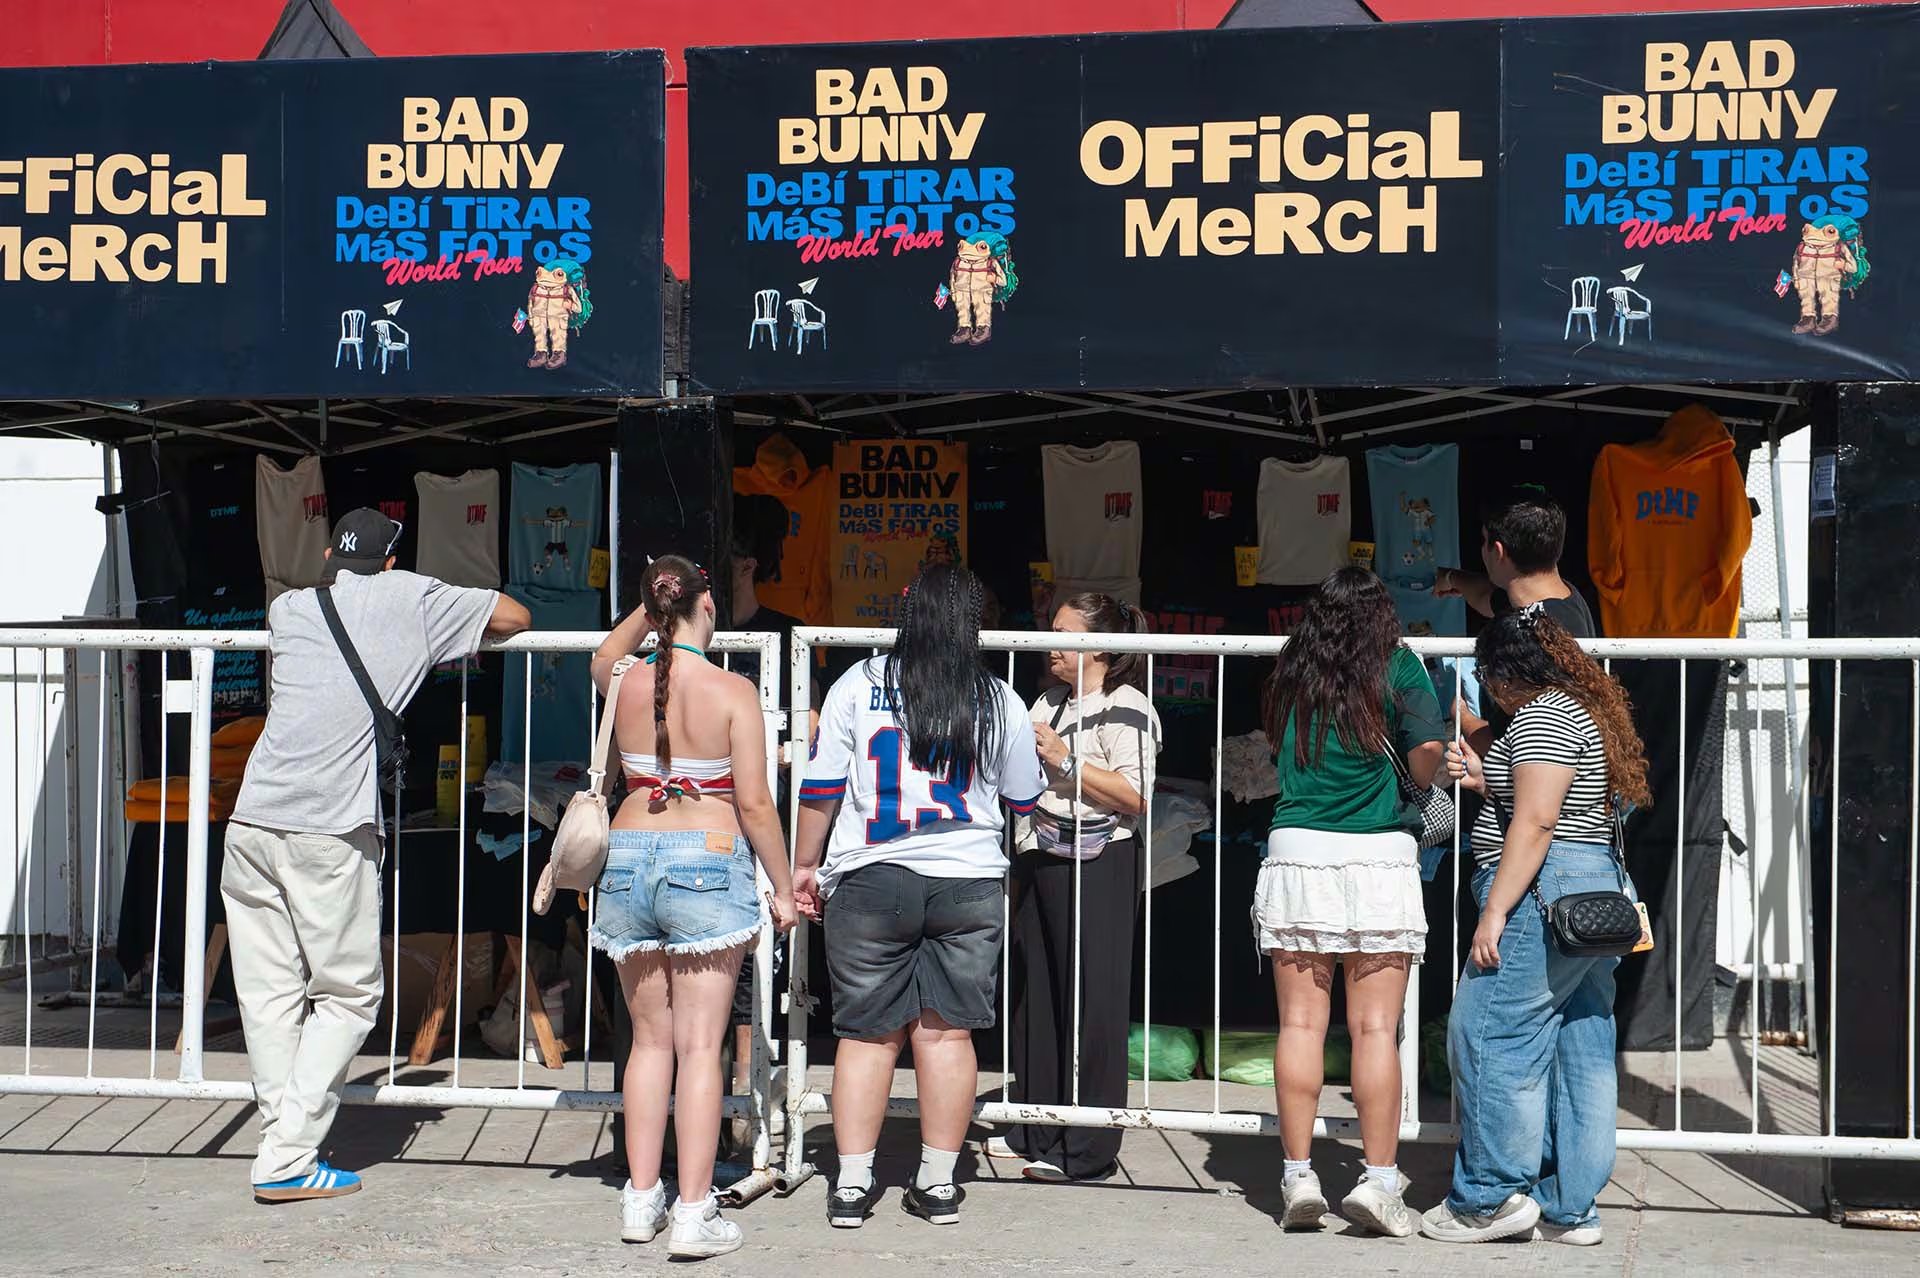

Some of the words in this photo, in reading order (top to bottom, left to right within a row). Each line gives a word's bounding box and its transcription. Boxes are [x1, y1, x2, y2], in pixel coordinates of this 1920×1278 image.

[1645, 40, 1795, 92] BAD
[815, 66, 948, 116] BAD
[403, 97, 529, 143] BAD
[1602, 88, 1838, 144] BUNNY
[778, 112, 986, 165] BUNNY
[1080, 110, 1483, 188] OFFiCiaL
[367, 143, 564, 189] BUNNY
[747, 170, 848, 206] DeBí
[858, 167, 1016, 205] TiRAR
[1566, 150, 1680, 189] DeBí
[1692, 146, 1870, 185] TiRAR
[336, 195, 432, 229] DeBí
[442, 196, 592, 230] TiRAR
[747, 206, 844, 241] MáS
[1124, 185, 1437, 257] MeRcH
[1565, 188, 1674, 225] MáS
[1619, 211, 1714, 249] World
[1717, 206, 1787, 241] Tour
[335, 230, 429, 263] MáS
[796, 227, 881, 264] World
[882, 223, 944, 257] Tour
[382, 252, 463, 286] World
[464, 249, 523, 281] Tour
[861, 445, 938, 471] BAD
[839, 472, 960, 499] BUNNY
